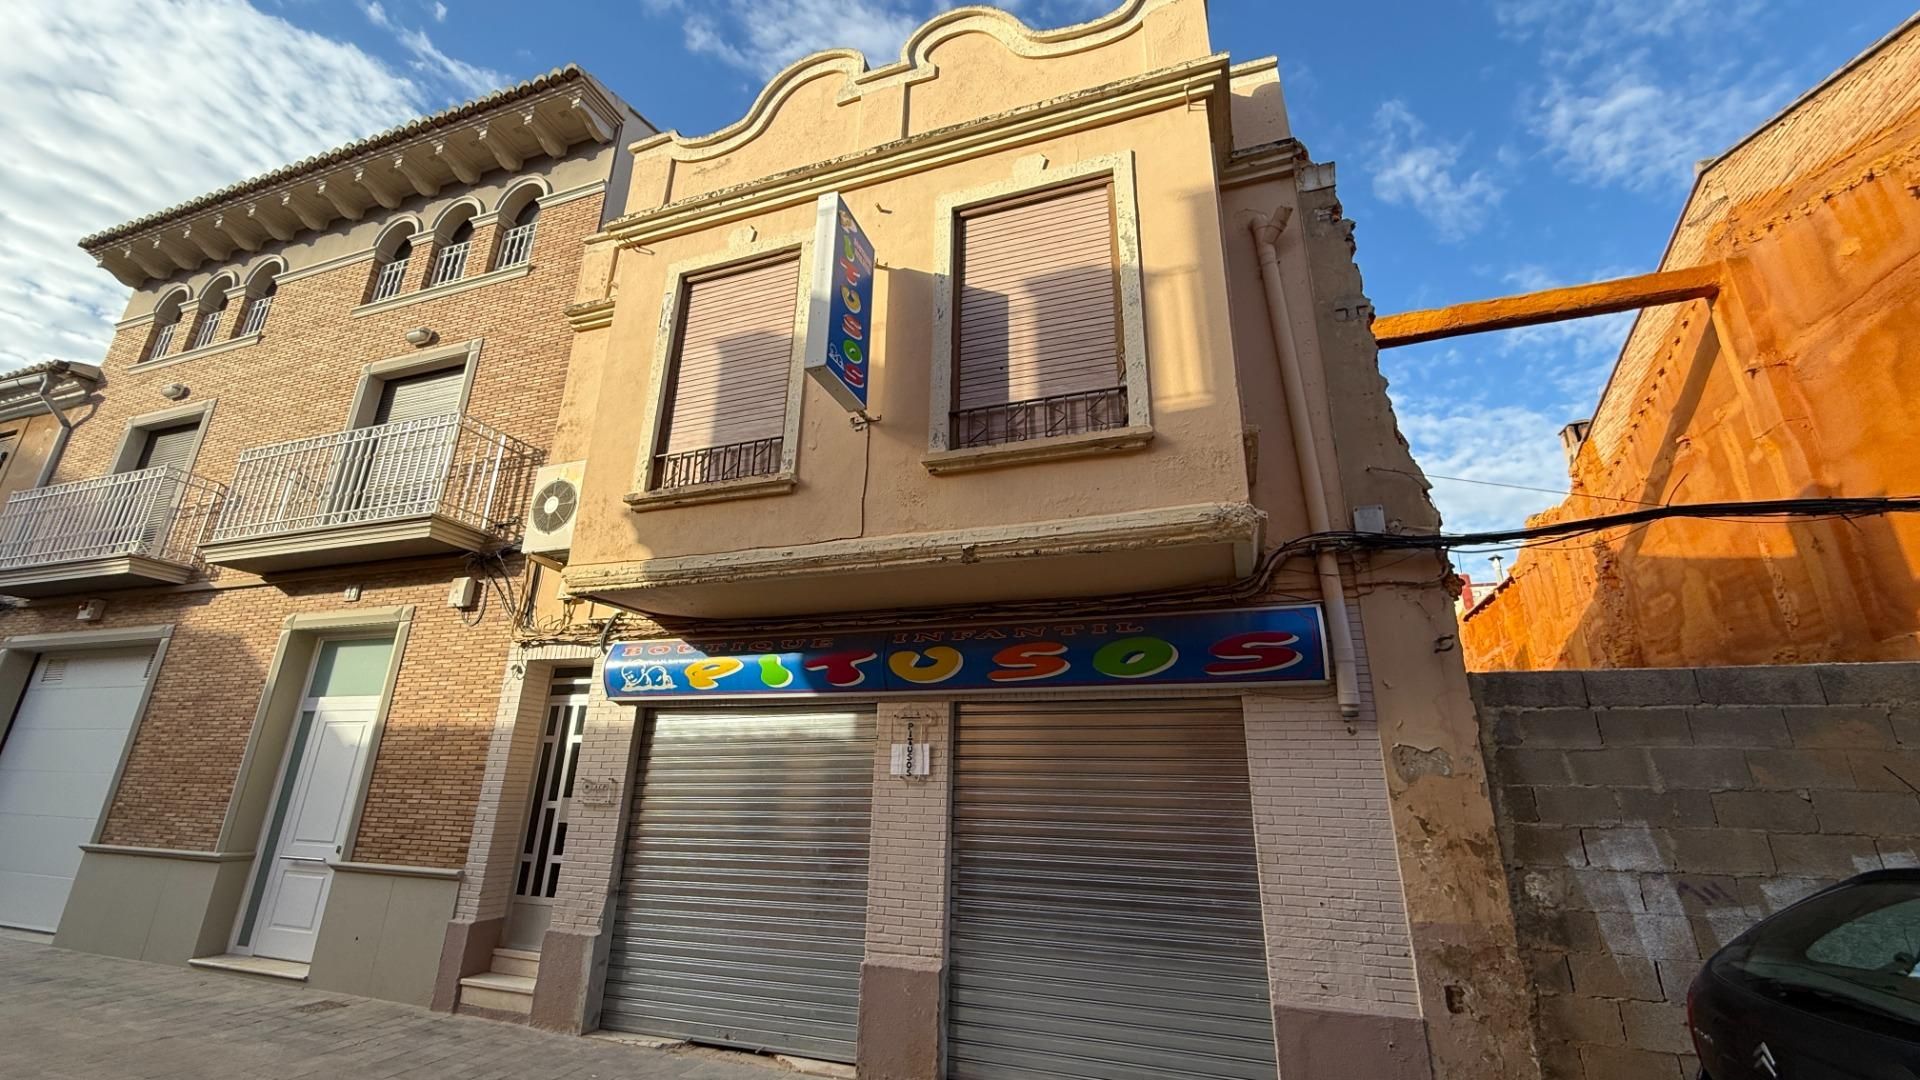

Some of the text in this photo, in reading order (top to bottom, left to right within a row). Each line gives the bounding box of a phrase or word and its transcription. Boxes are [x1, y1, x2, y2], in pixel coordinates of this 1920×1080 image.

[839, 209, 865, 388] PITUSOS
[622, 622, 1145, 657] BOUTIQUE INFANTIL
[683, 630, 1304, 690] PITUSOS
